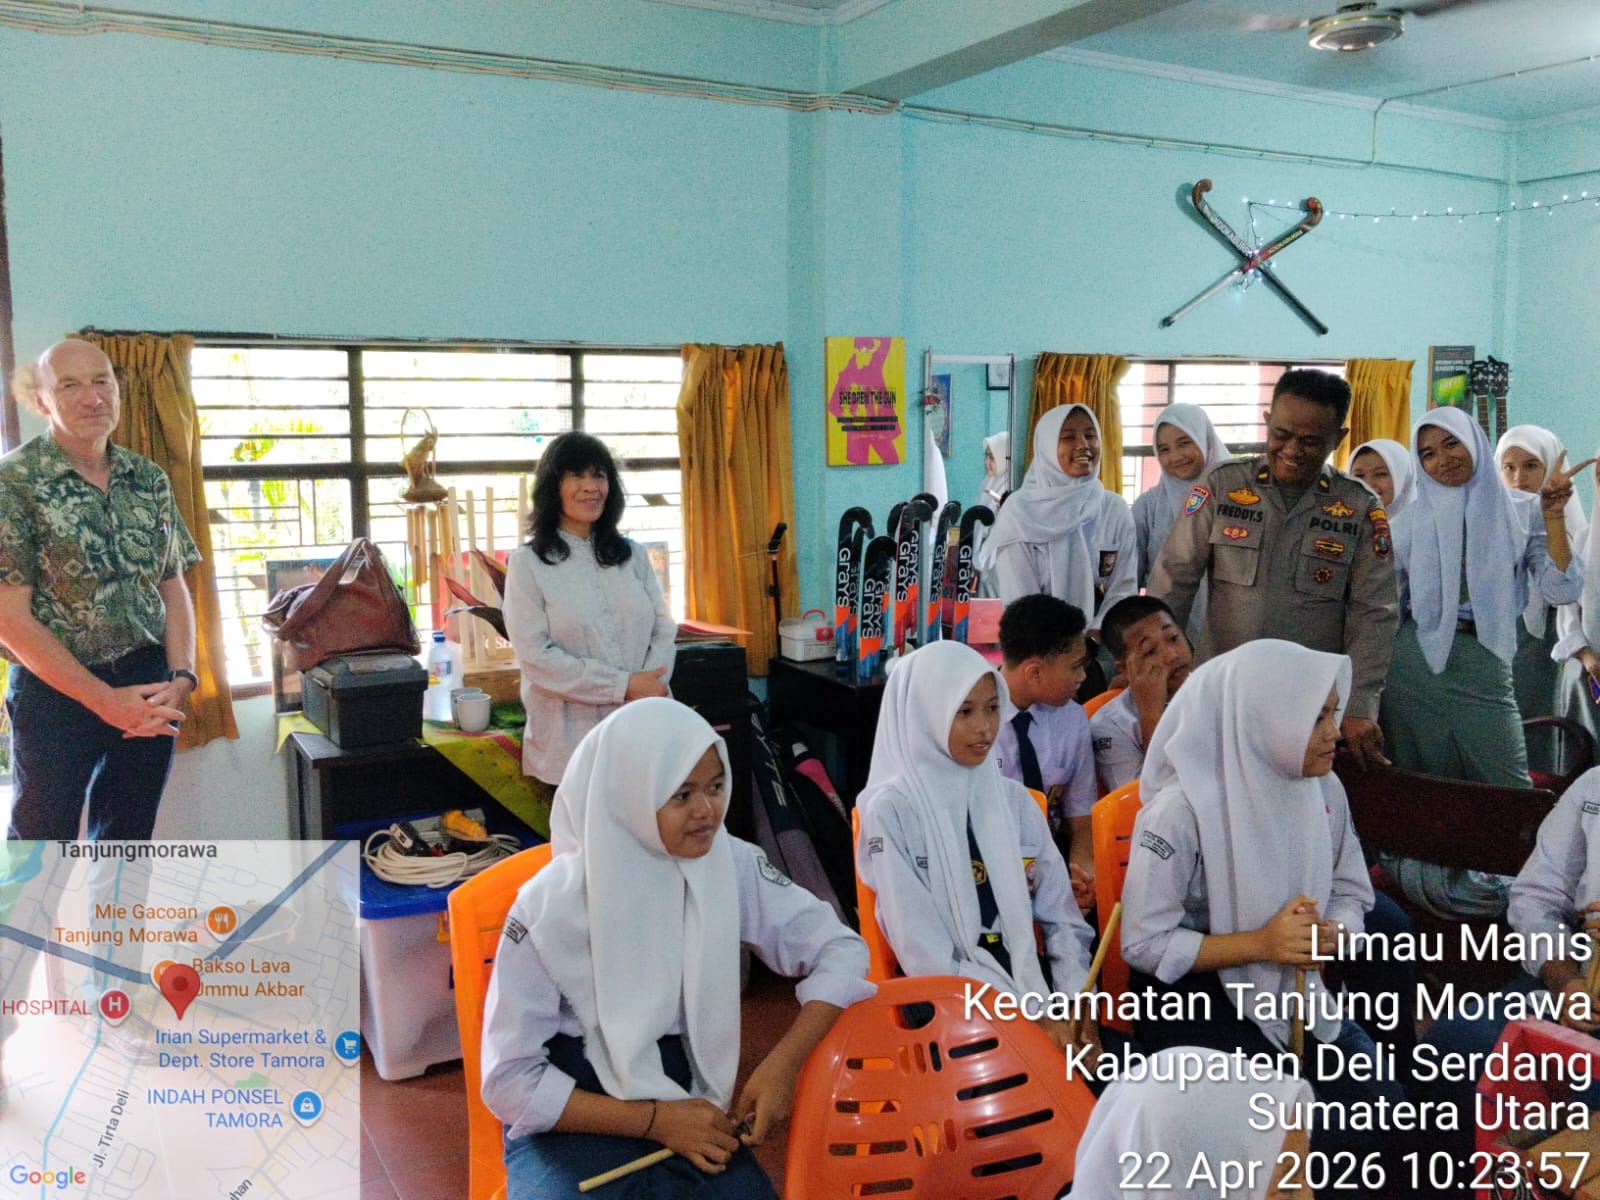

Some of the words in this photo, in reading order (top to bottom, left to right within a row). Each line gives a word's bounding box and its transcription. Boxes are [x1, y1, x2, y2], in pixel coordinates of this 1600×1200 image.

[839, 391, 851, 405] SHE
[870, 391, 882, 404] THE
[1310, 516, 1358, 536] POLRI
[838, 547, 851, 608] Grays
[897, 541, 911, 602] Grays
[958, 545, 973, 603] Grays
[862, 578, 876, 640] Grays
